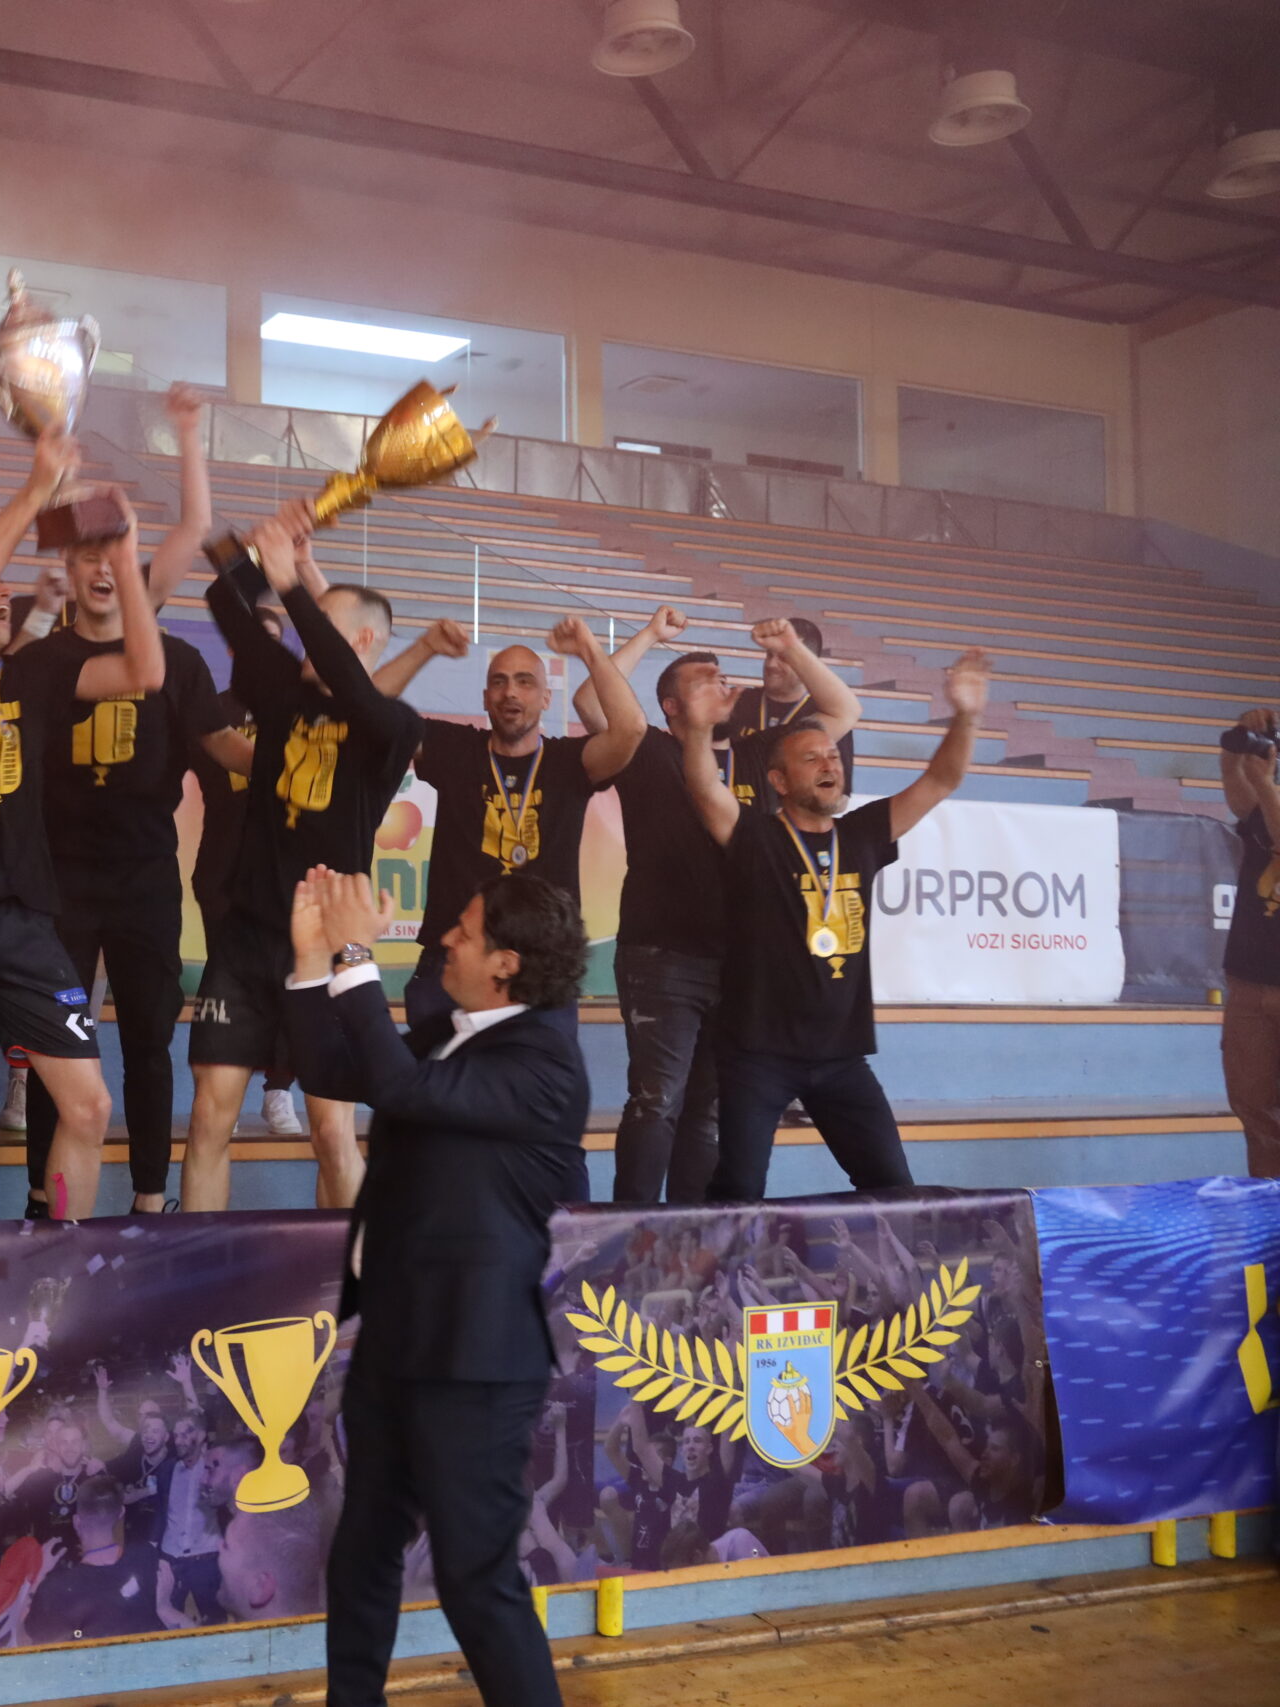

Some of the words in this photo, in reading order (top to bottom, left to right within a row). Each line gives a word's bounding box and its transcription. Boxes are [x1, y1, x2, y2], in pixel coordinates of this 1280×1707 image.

[876, 868, 1087, 919] URPROM
[967, 933, 1005, 949] VOZI
[1011, 934, 1088, 950] SIGURNO
[756, 1338, 773, 1350] RK
[756, 1358, 777, 1369] 1956
